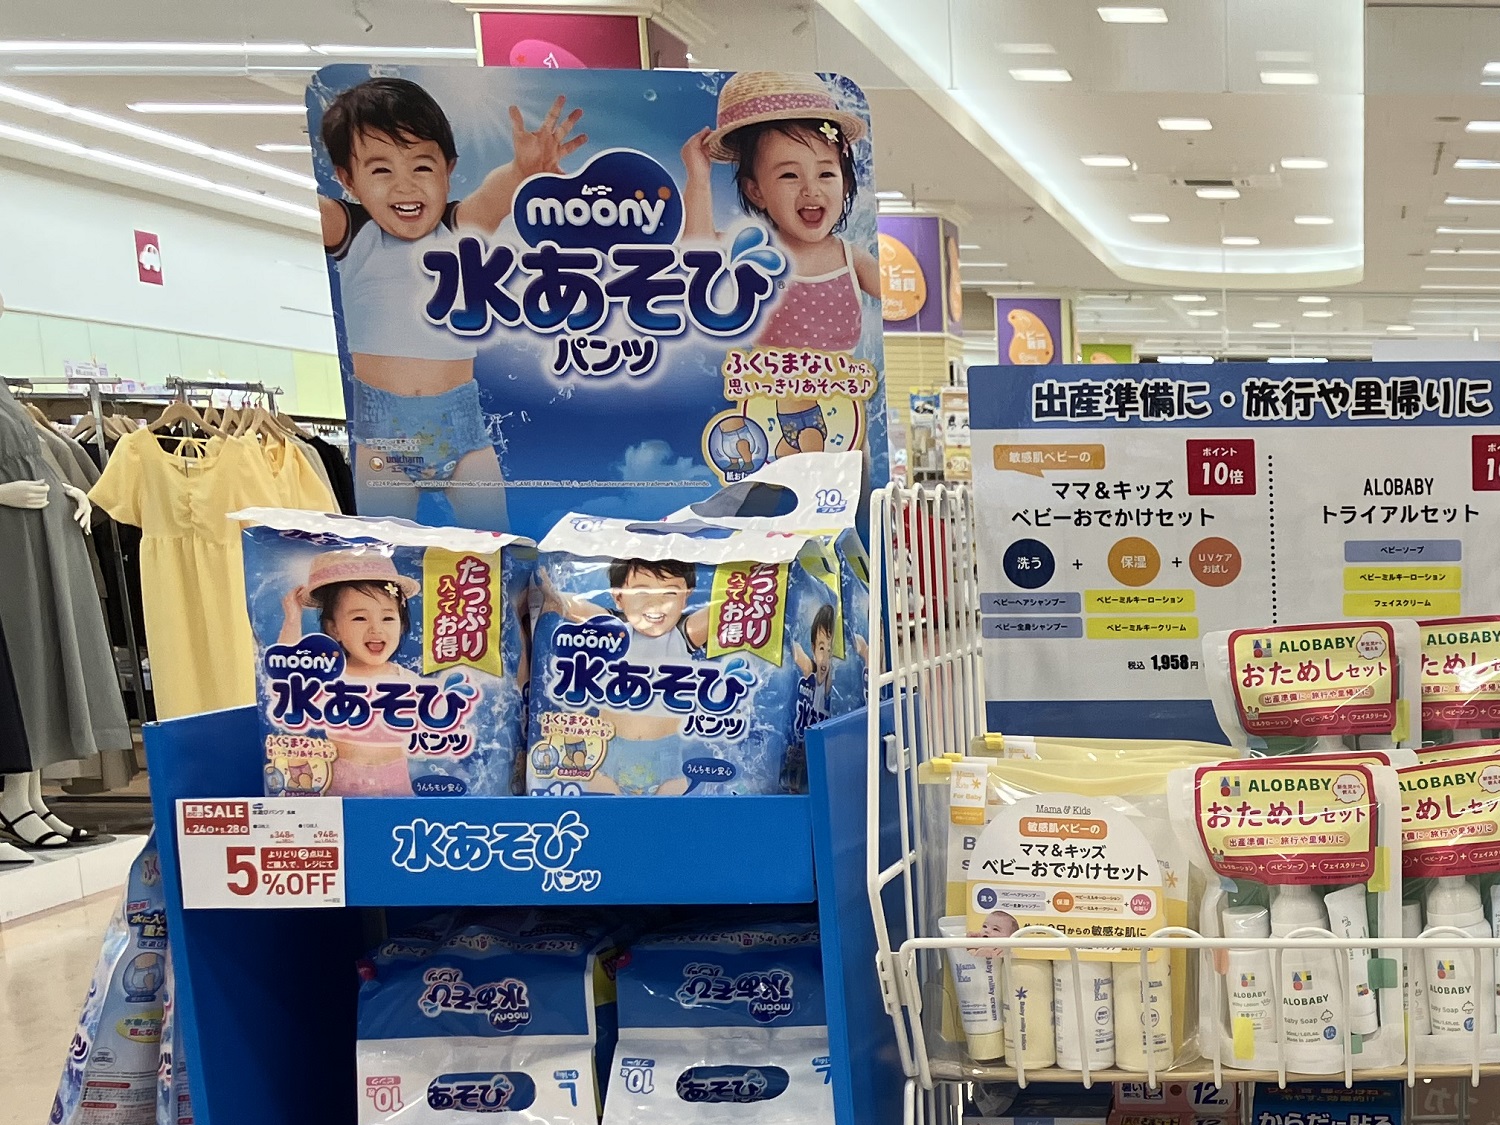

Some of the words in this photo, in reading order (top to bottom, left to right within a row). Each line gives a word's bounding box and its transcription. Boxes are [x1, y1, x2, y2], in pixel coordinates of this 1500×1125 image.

[525, 193, 663, 234] moony
[423, 236, 769, 335] 水あそび
[552, 337, 658, 376] パンツ
[1033, 378, 1494, 424] 出産準備に・旅行や里帰りに
[1008, 450, 1092, 464] 敏感肌ベビーの
[1201, 446, 1238, 457] ポイント
[1201, 461, 1245, 485] 10倍
[1363, 477, 1434, 496] ALOBABY
[1011, 507, 1216, 528] ベビーおでかけセット
[1321, 505, 1480, 524] トライアルセット
[1016, 555, 1042, 570] 洗う
[1120, 554, 1148, 569] 保湿
[1279, 636, 1356, 653] ALOBABY
[1127, 660, 1146, 671] 税込
[1150, 653, 1199, 672] 1,958円
[554, 658, 743, 708] 水あそび
[1242, 659, 1388, 688] おためしセット
[273, 676, 468, 731] 水あそび
[407, 731, 471, 757] パンツ
[1248, 778, 1332, 793] ALOBABY
[204, 805, 244, 818] SALE
[1207, 801, 1366, 829] おためしセット
[1027, 822, 1100, 834] 敏感肌ベビーの
[392, 818, 589, 873] 水あそび
[1020, 844, 1107, 859] ママ＆キッズ
[982, 859, 1148, 881] ベビーおでかけセット
[1233, 991, 1267, 999] ALOBABY
[1283, 994, 1330, 1006] ALOBABY
